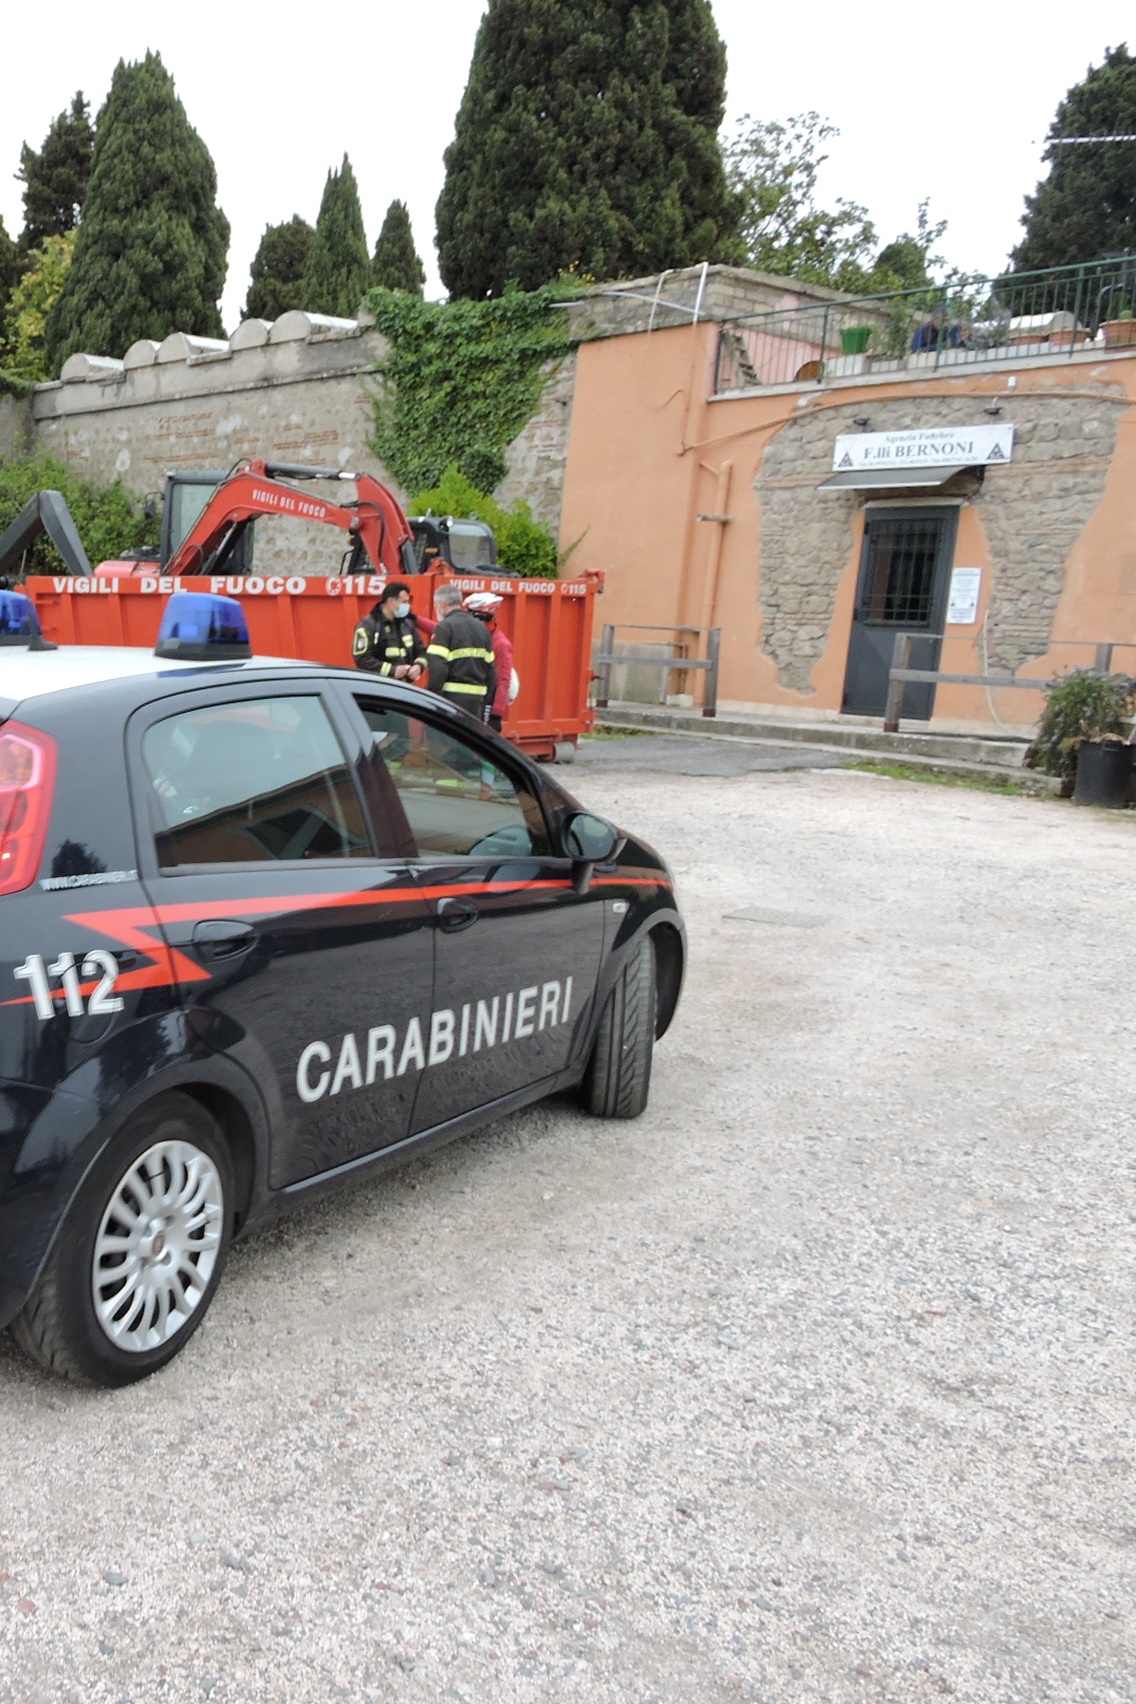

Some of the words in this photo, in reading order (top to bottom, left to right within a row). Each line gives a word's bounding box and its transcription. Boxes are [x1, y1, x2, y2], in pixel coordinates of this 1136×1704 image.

[864, 446, 892, 460] F.lli
[895, 441, 974, 458] BERNONI
[252, 489, 278, 506] VIGILI
[279, 496, 295, 510] DEL
[298, 501, 326, 518] FUOCO
[53, 577, 119, 593] VIGILI
[140, 577, 188, 593] DEL
[210, 576, 307, 595] FUOCO
[342, 576, 387, 594] 115
[449, 579, 485, 591] VIGILI
[491, 580, 513, 592] DEL
[518, 581, 556, 593] FUOCO
[568, 583, 587, 595] 115
[12, 949, 125, 1020] 112
[296, 976, 574, 1103] CARABINIERI
